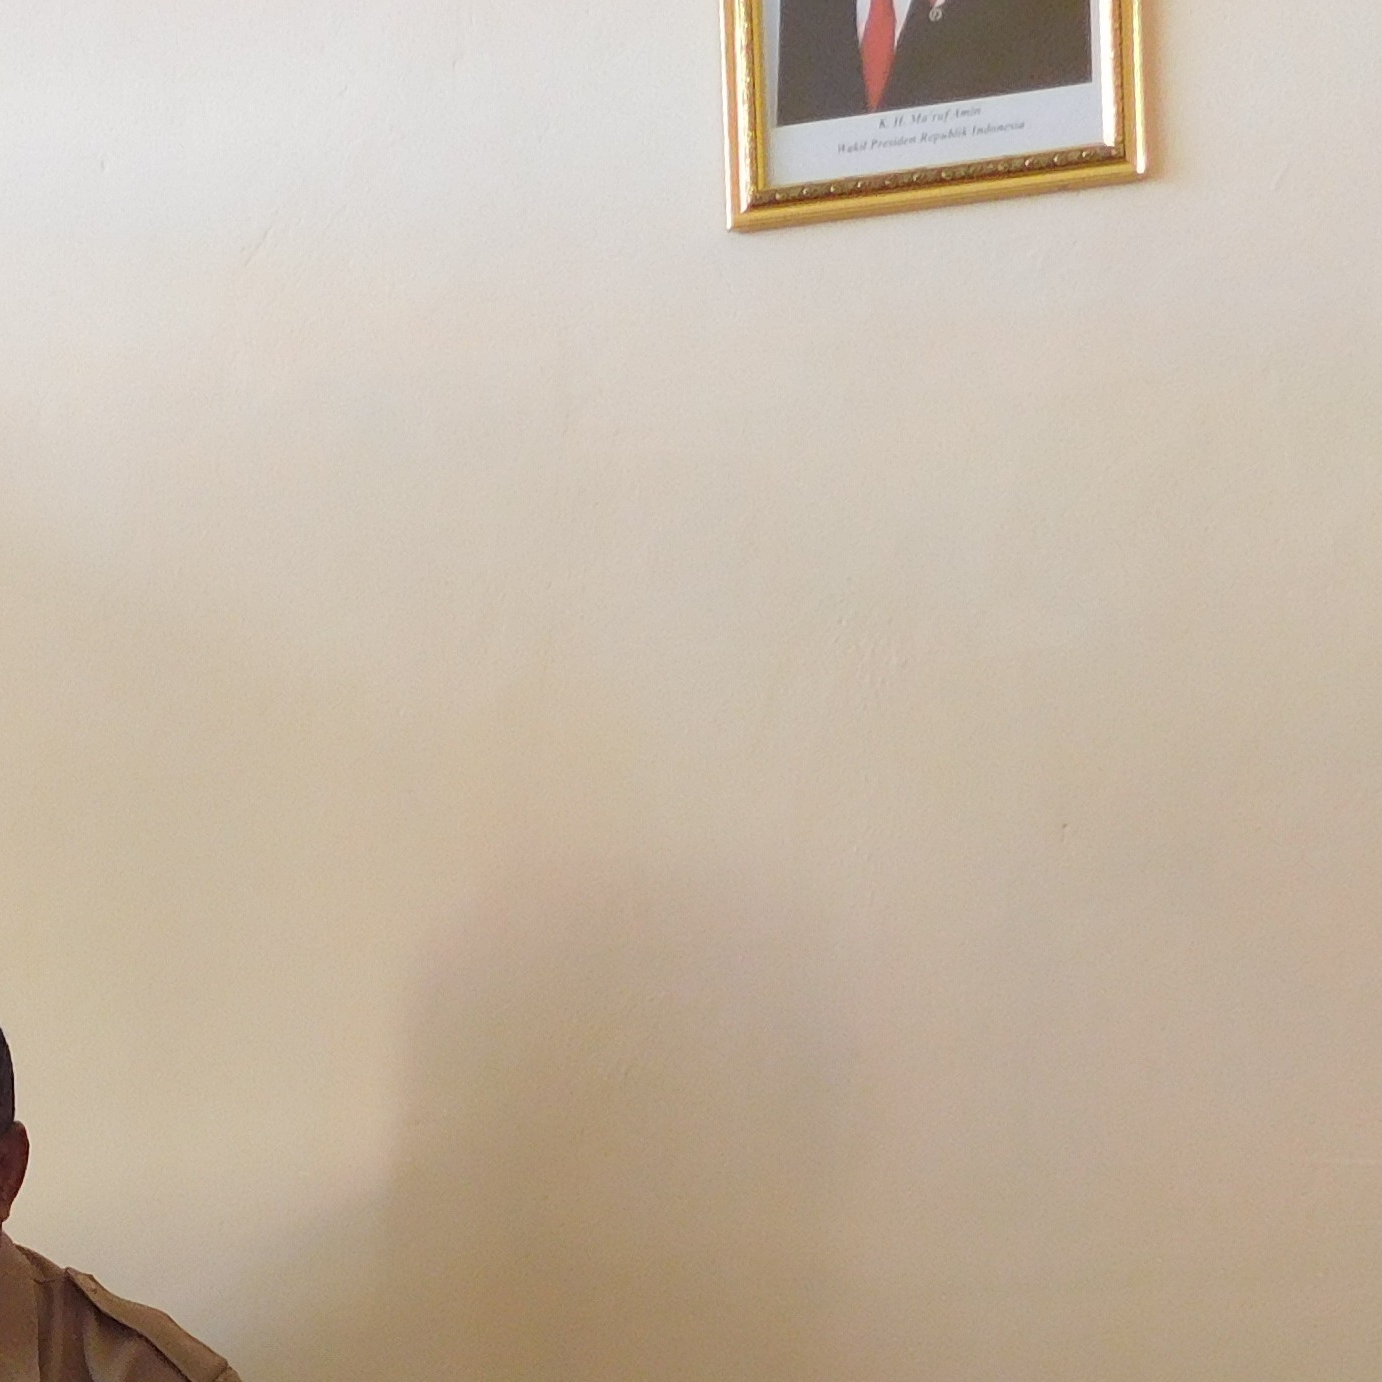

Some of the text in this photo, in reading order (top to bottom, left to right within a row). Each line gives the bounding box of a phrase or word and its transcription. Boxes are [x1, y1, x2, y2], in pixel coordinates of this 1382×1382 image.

[869, 134, 917, 152] Presiden
[919, 125, 968, 145] Republik
[971, 119, 1026, 138] Indonesia
